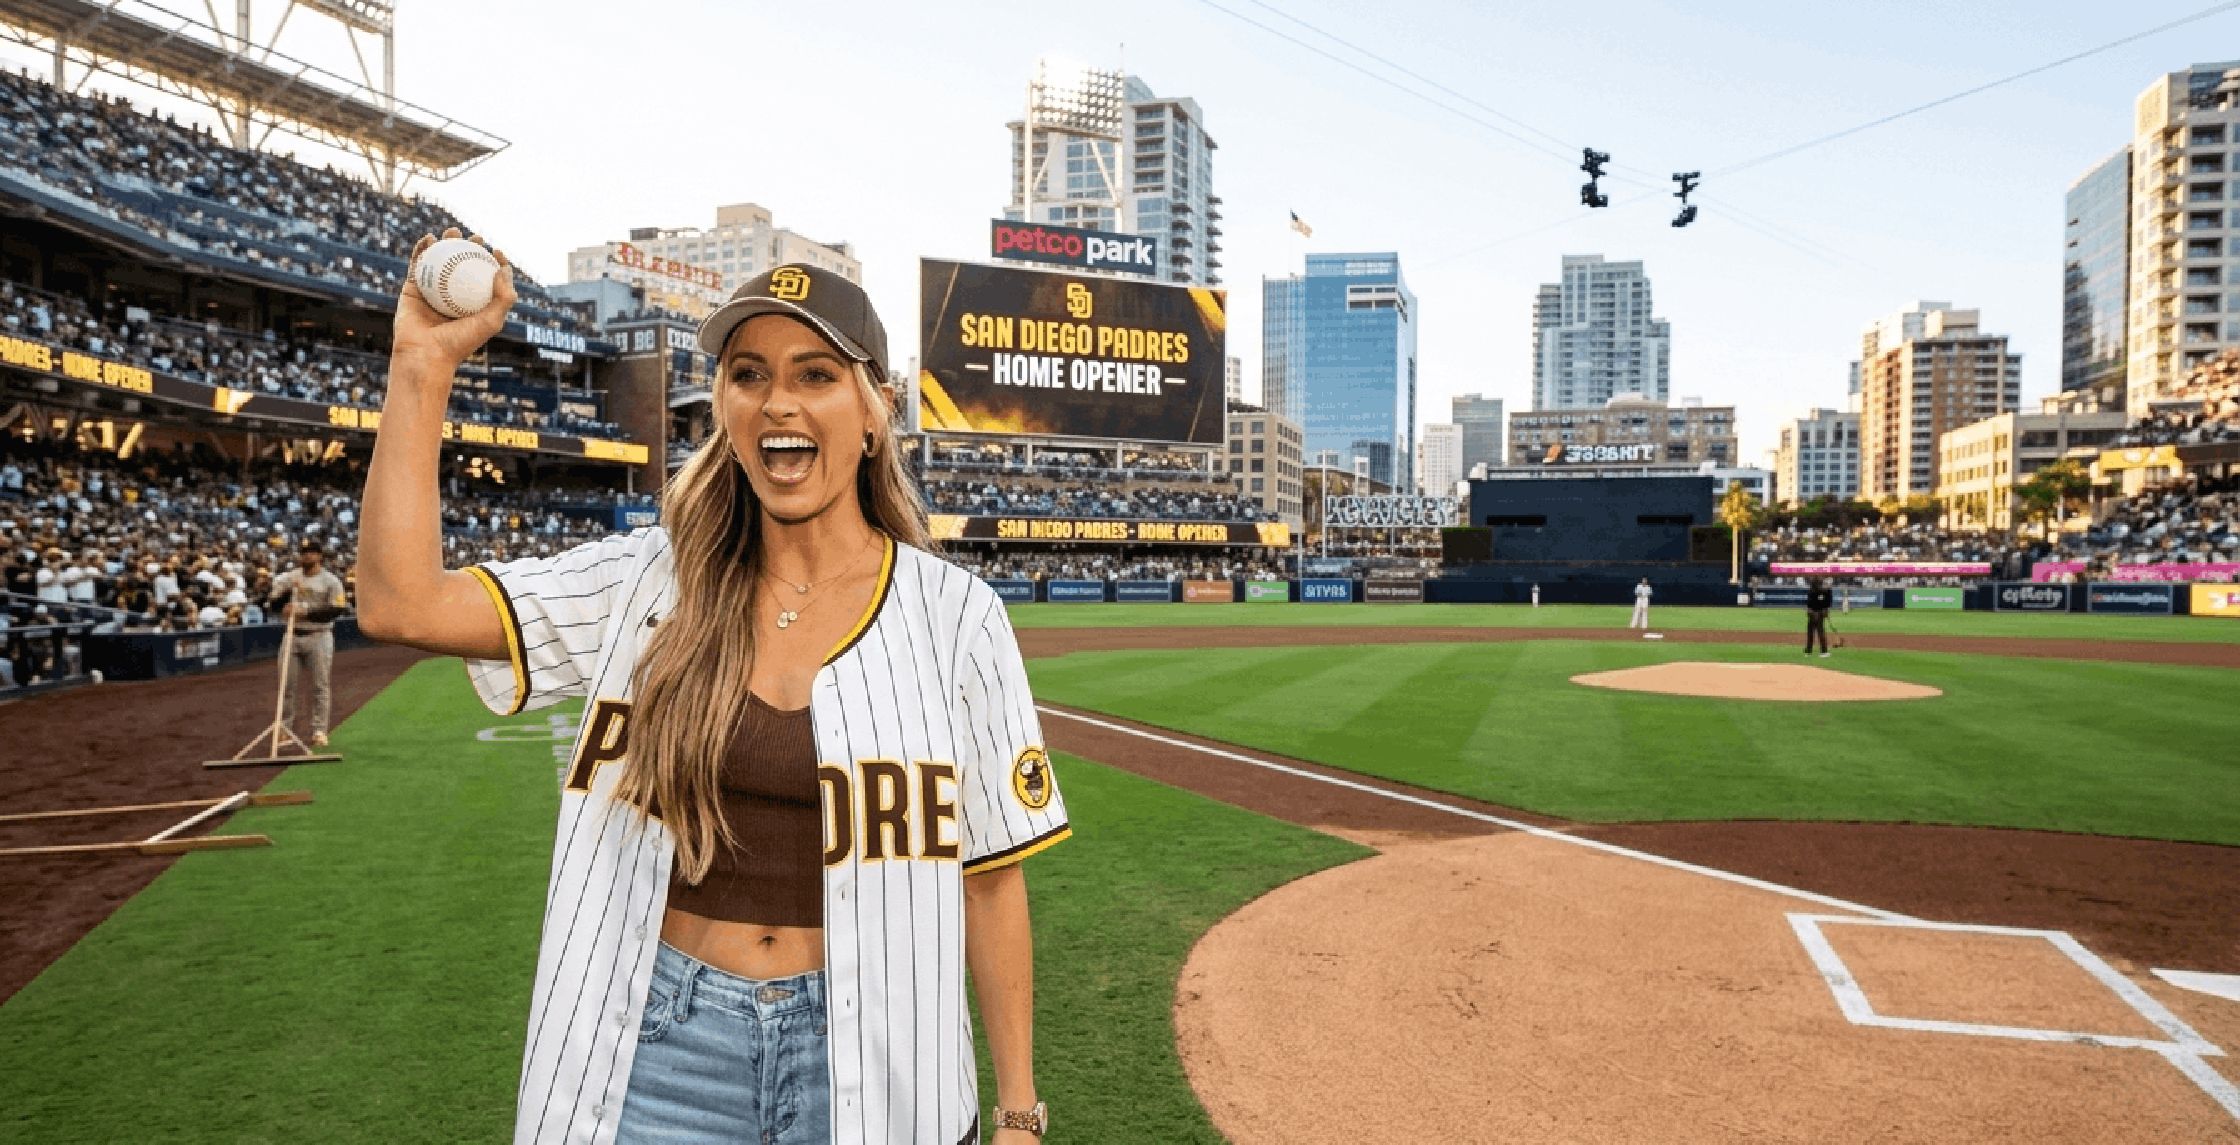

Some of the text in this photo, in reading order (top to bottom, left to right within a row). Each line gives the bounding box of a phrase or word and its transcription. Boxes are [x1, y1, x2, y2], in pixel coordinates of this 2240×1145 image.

[997, 227, 1153, 265] petco park
[961, 312, 1189, 363] SAN DIEGO PADRES
[993, 352, 1162, 395] HOME OPENER
[565, 698, 648, 808] P
